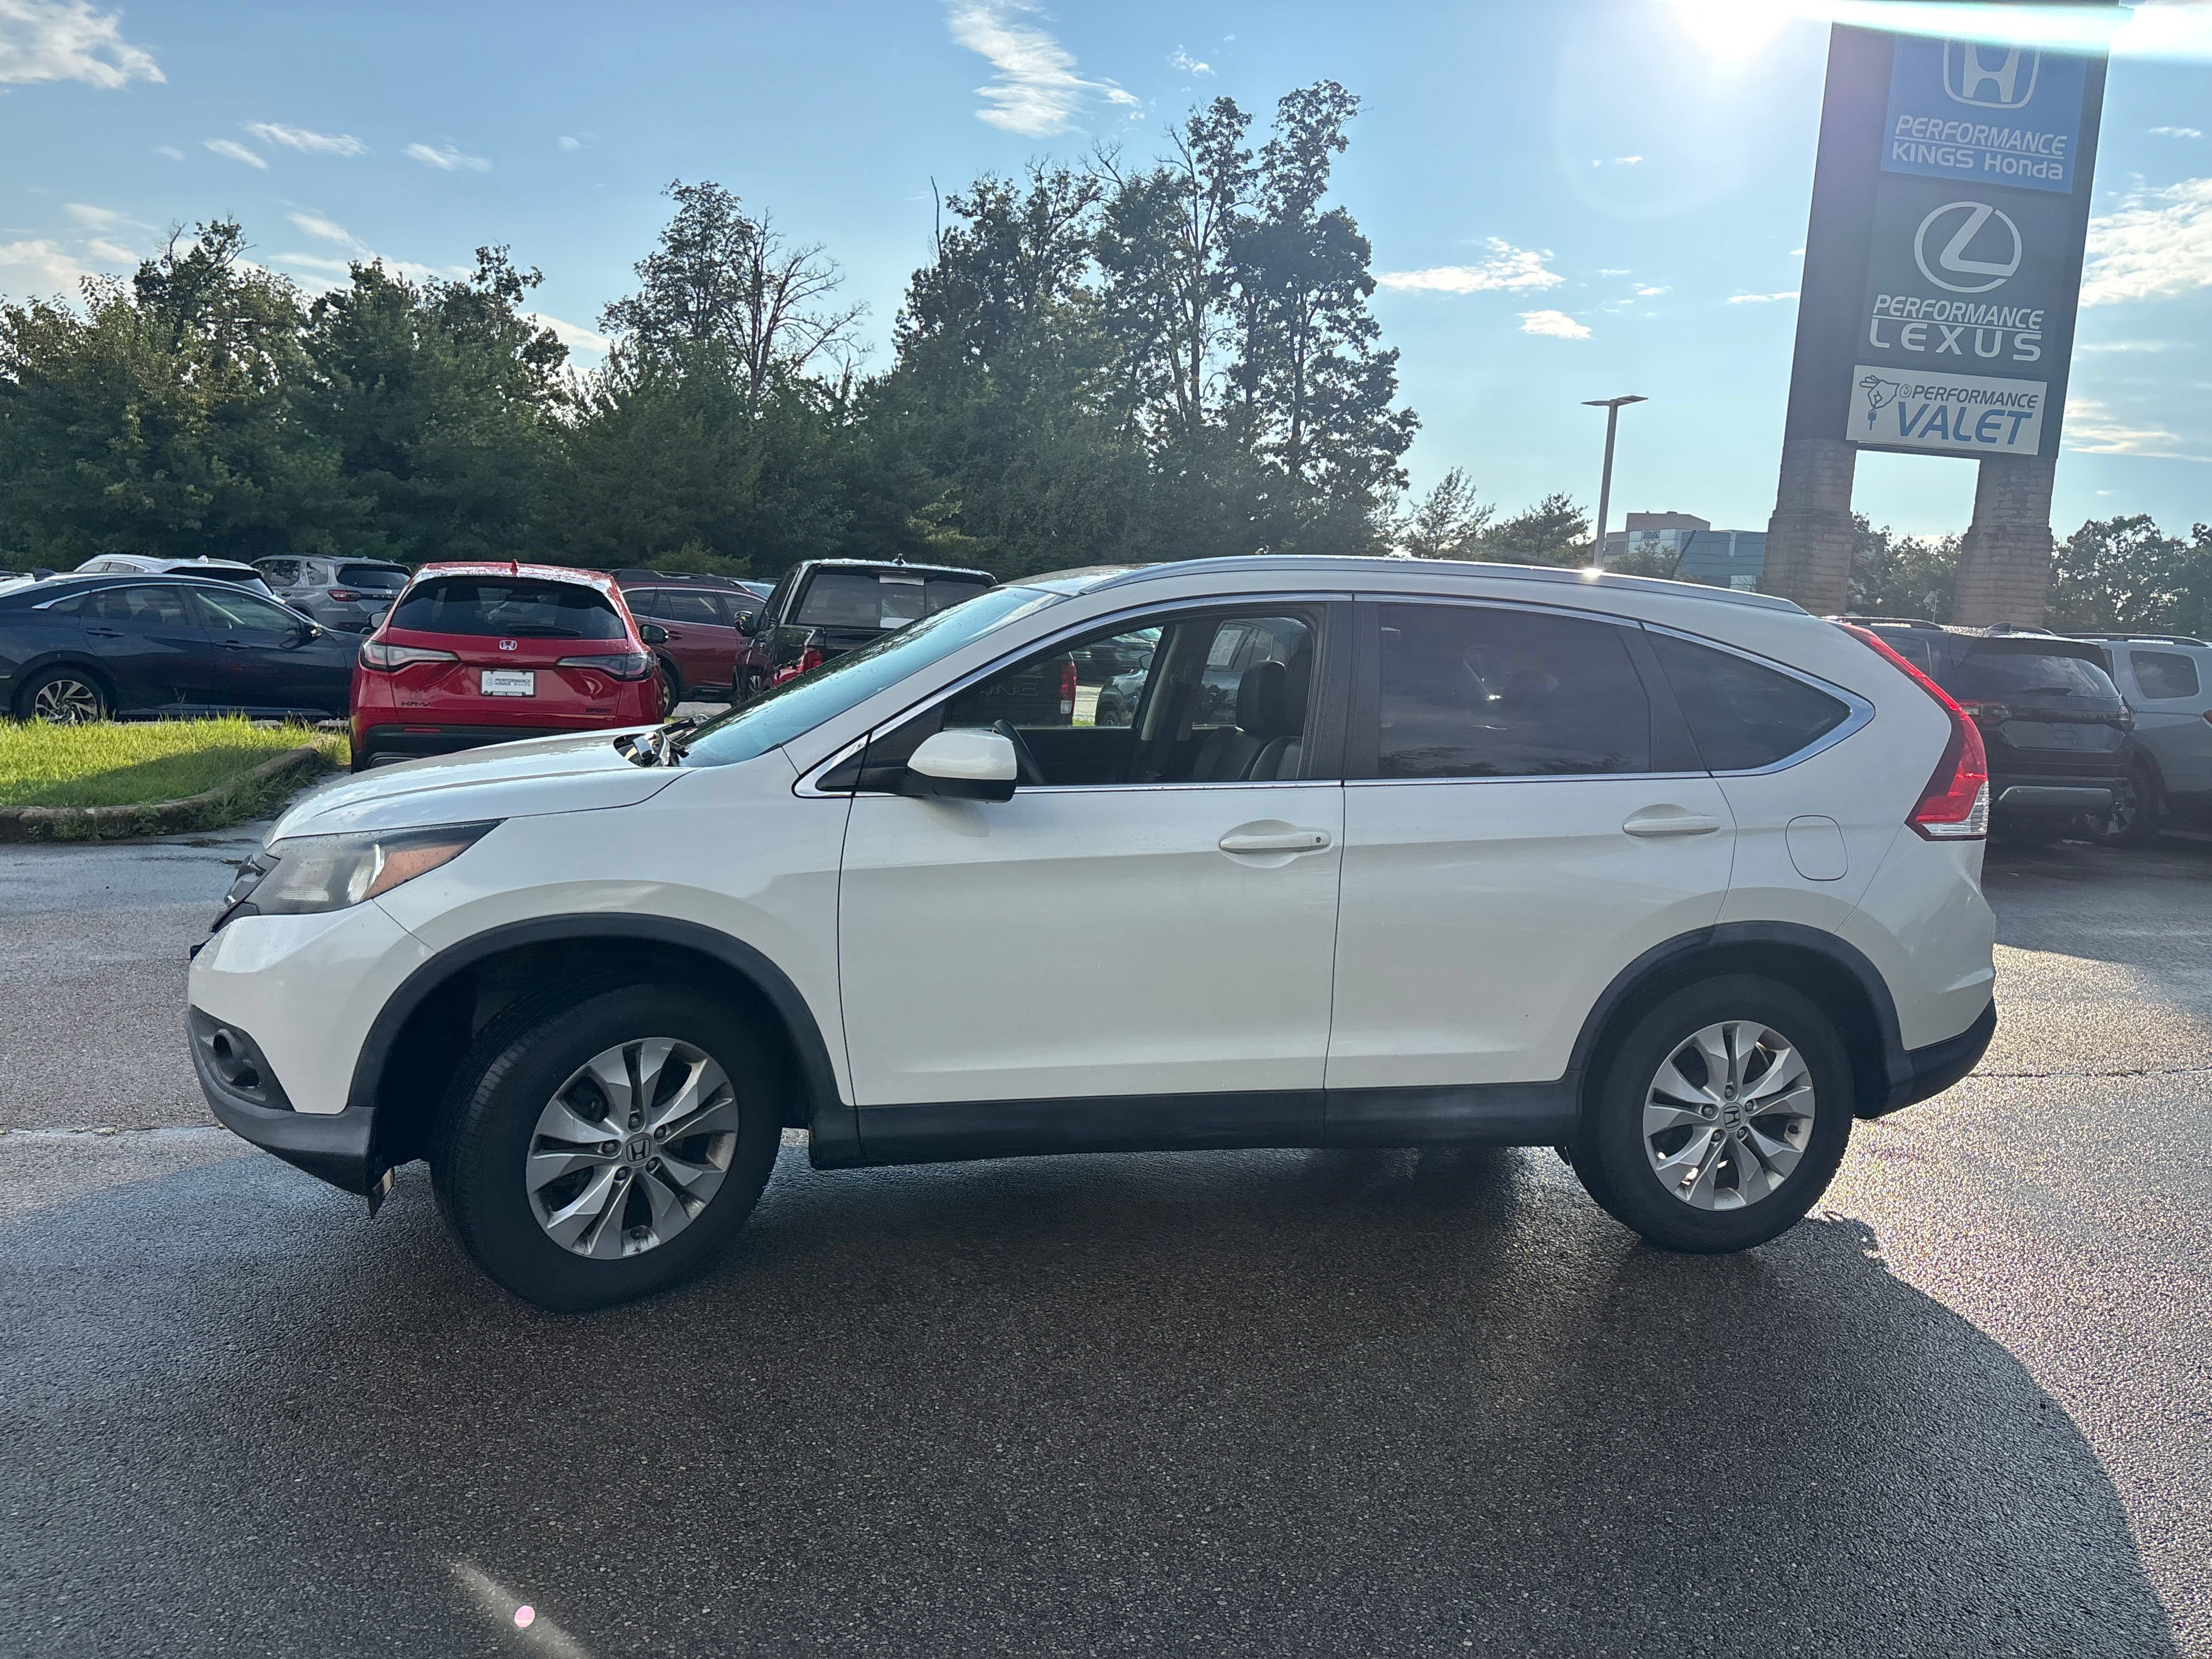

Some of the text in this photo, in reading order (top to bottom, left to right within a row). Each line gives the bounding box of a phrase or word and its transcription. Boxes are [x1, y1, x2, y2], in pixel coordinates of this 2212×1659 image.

[1895, 115, 2068, 155] PERFORMANCE
[1892, 142, 2063, 180] KINGS Honda
[1873, 294, 2045, 329] PERFORMANCE
[1869, 319, 2042, 362] LEXUS
[1912, 385, 2039, 409] PERFORMANCE
[1898, 401, 2033, 445] VALET
